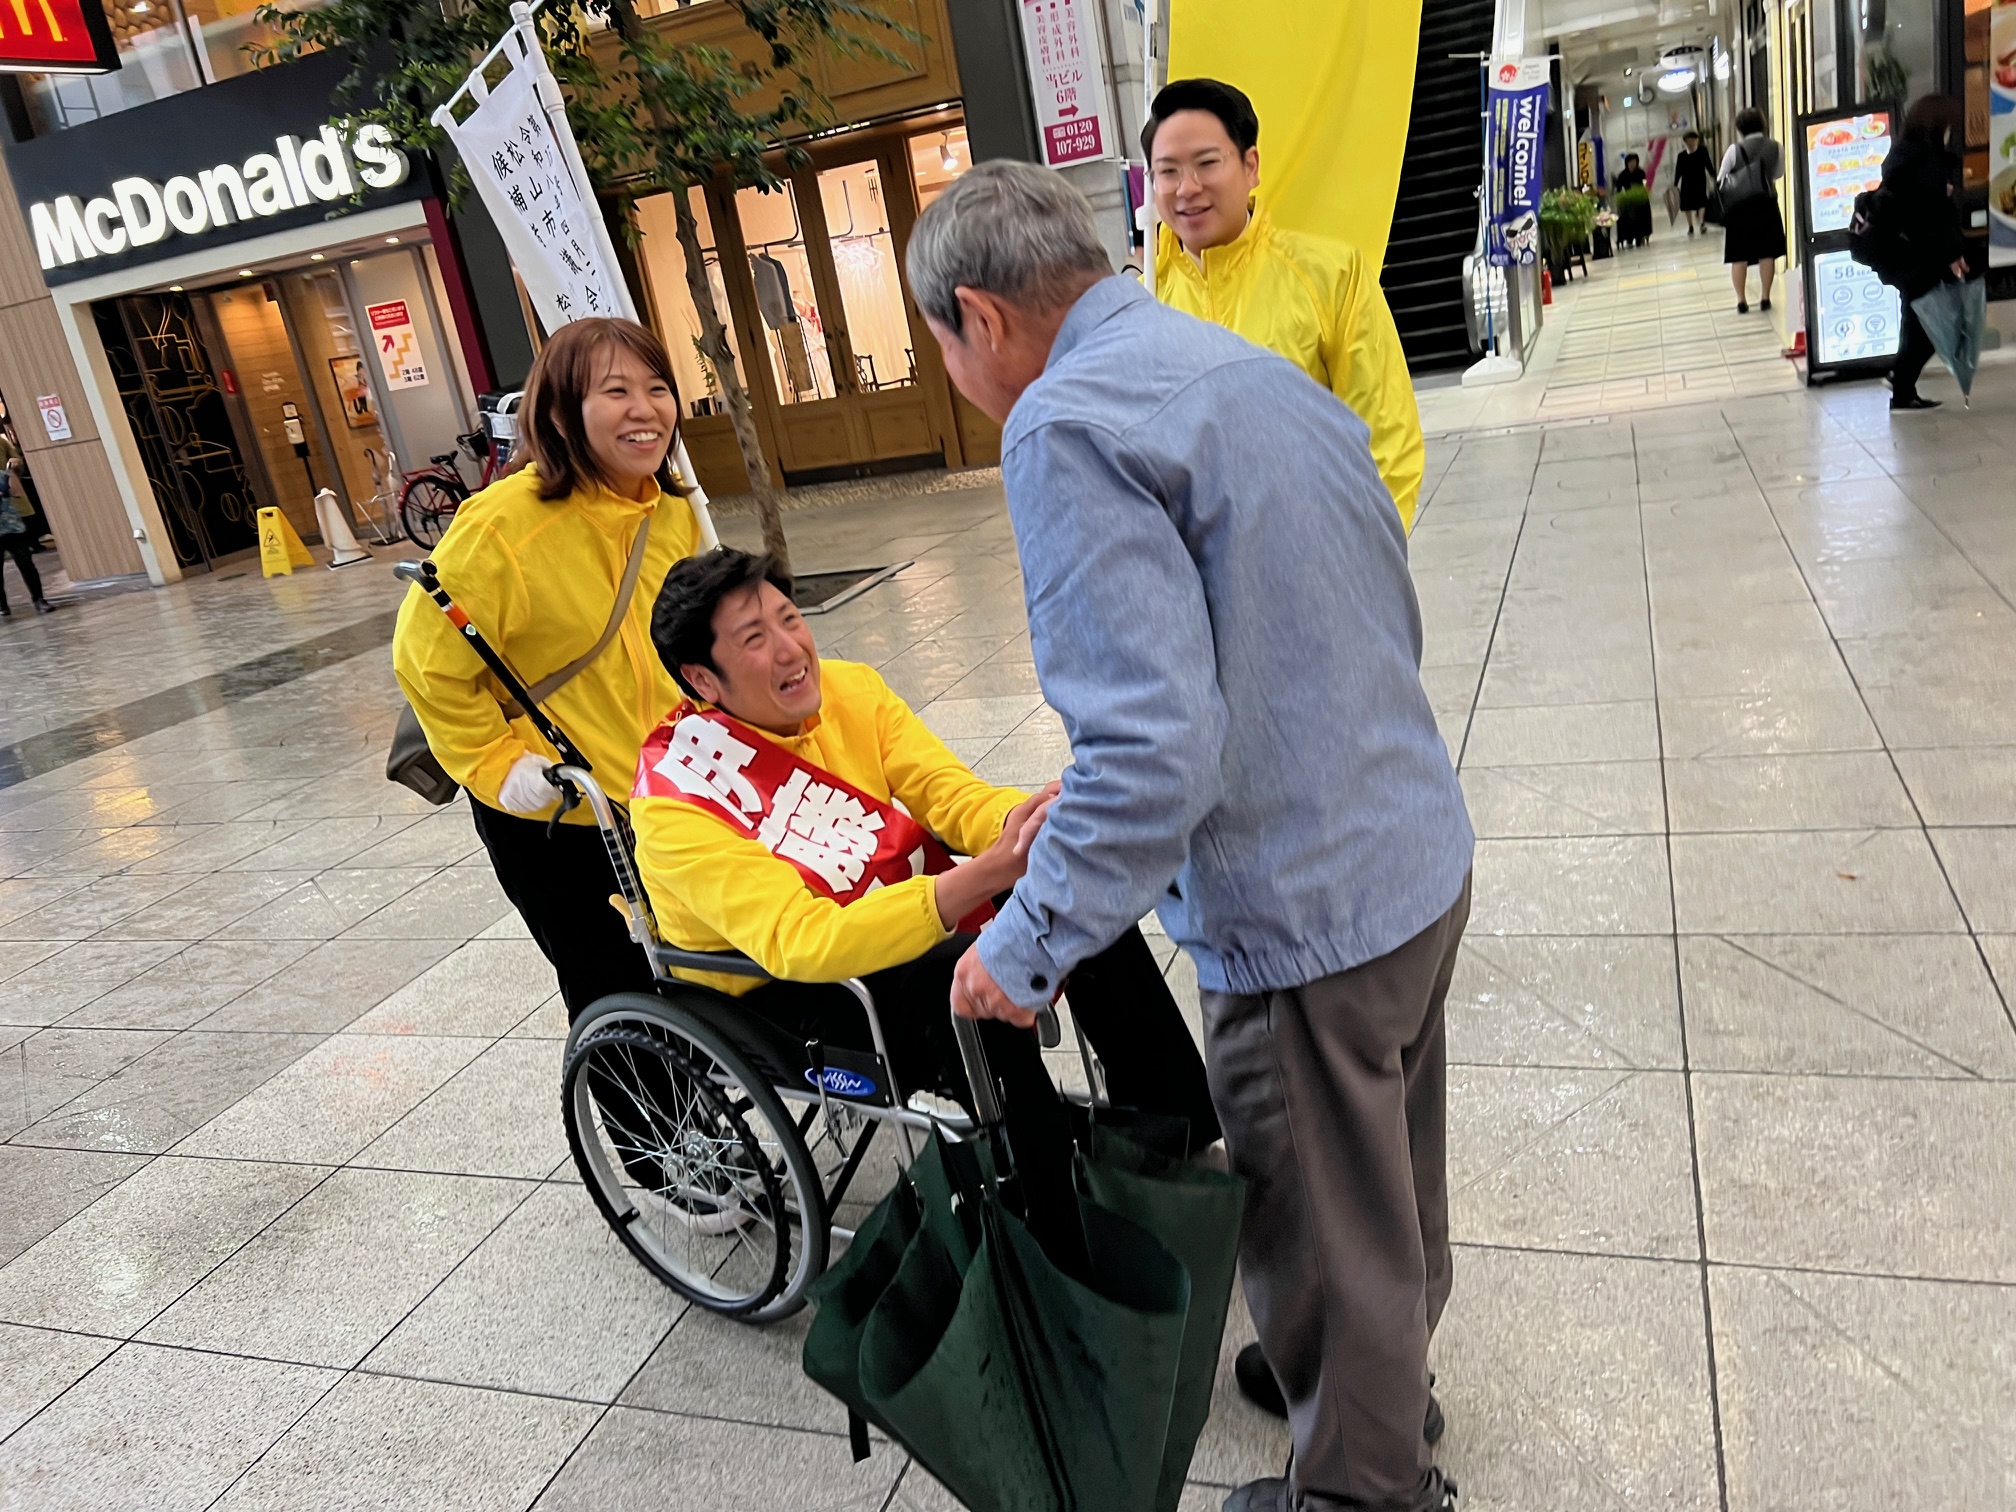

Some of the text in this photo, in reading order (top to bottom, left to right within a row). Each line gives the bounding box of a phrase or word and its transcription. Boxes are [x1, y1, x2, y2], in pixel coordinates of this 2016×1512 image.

[1045, 68, 1083, 90] 当ビル
[1056, 87, 1078, 105] 6階
[1066, 118, 1094, 137] 0120
[1055, 134, 1096, 157] 107-929
[1513, 96, 1539, 208] welcome!
[1834, 264, 1855, 280] 58
[652, 713, 925, 896] 伊藤
